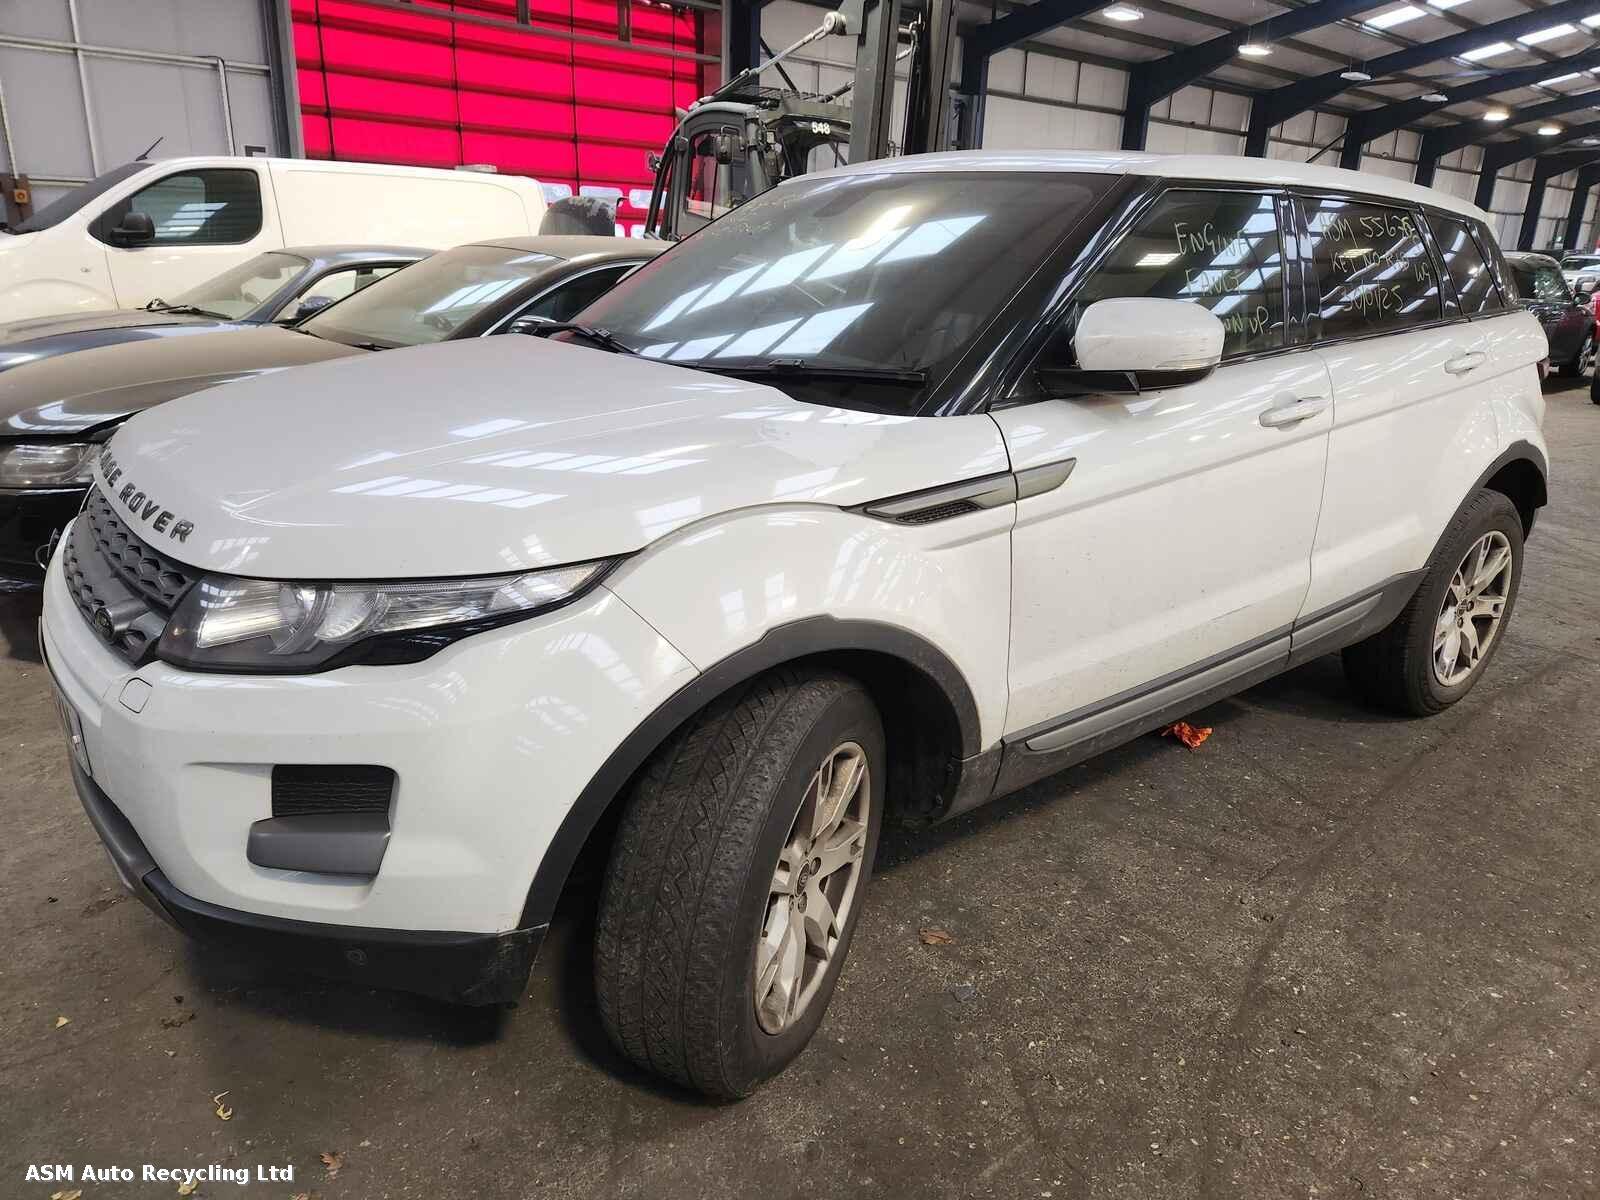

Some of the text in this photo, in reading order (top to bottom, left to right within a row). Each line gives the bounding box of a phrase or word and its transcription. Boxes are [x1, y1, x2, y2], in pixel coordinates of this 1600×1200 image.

[811, 121, 831, 135] 548
[1174, 222, 1249, 256] ENGINE
[118, 482, 195, 543] ROVER
